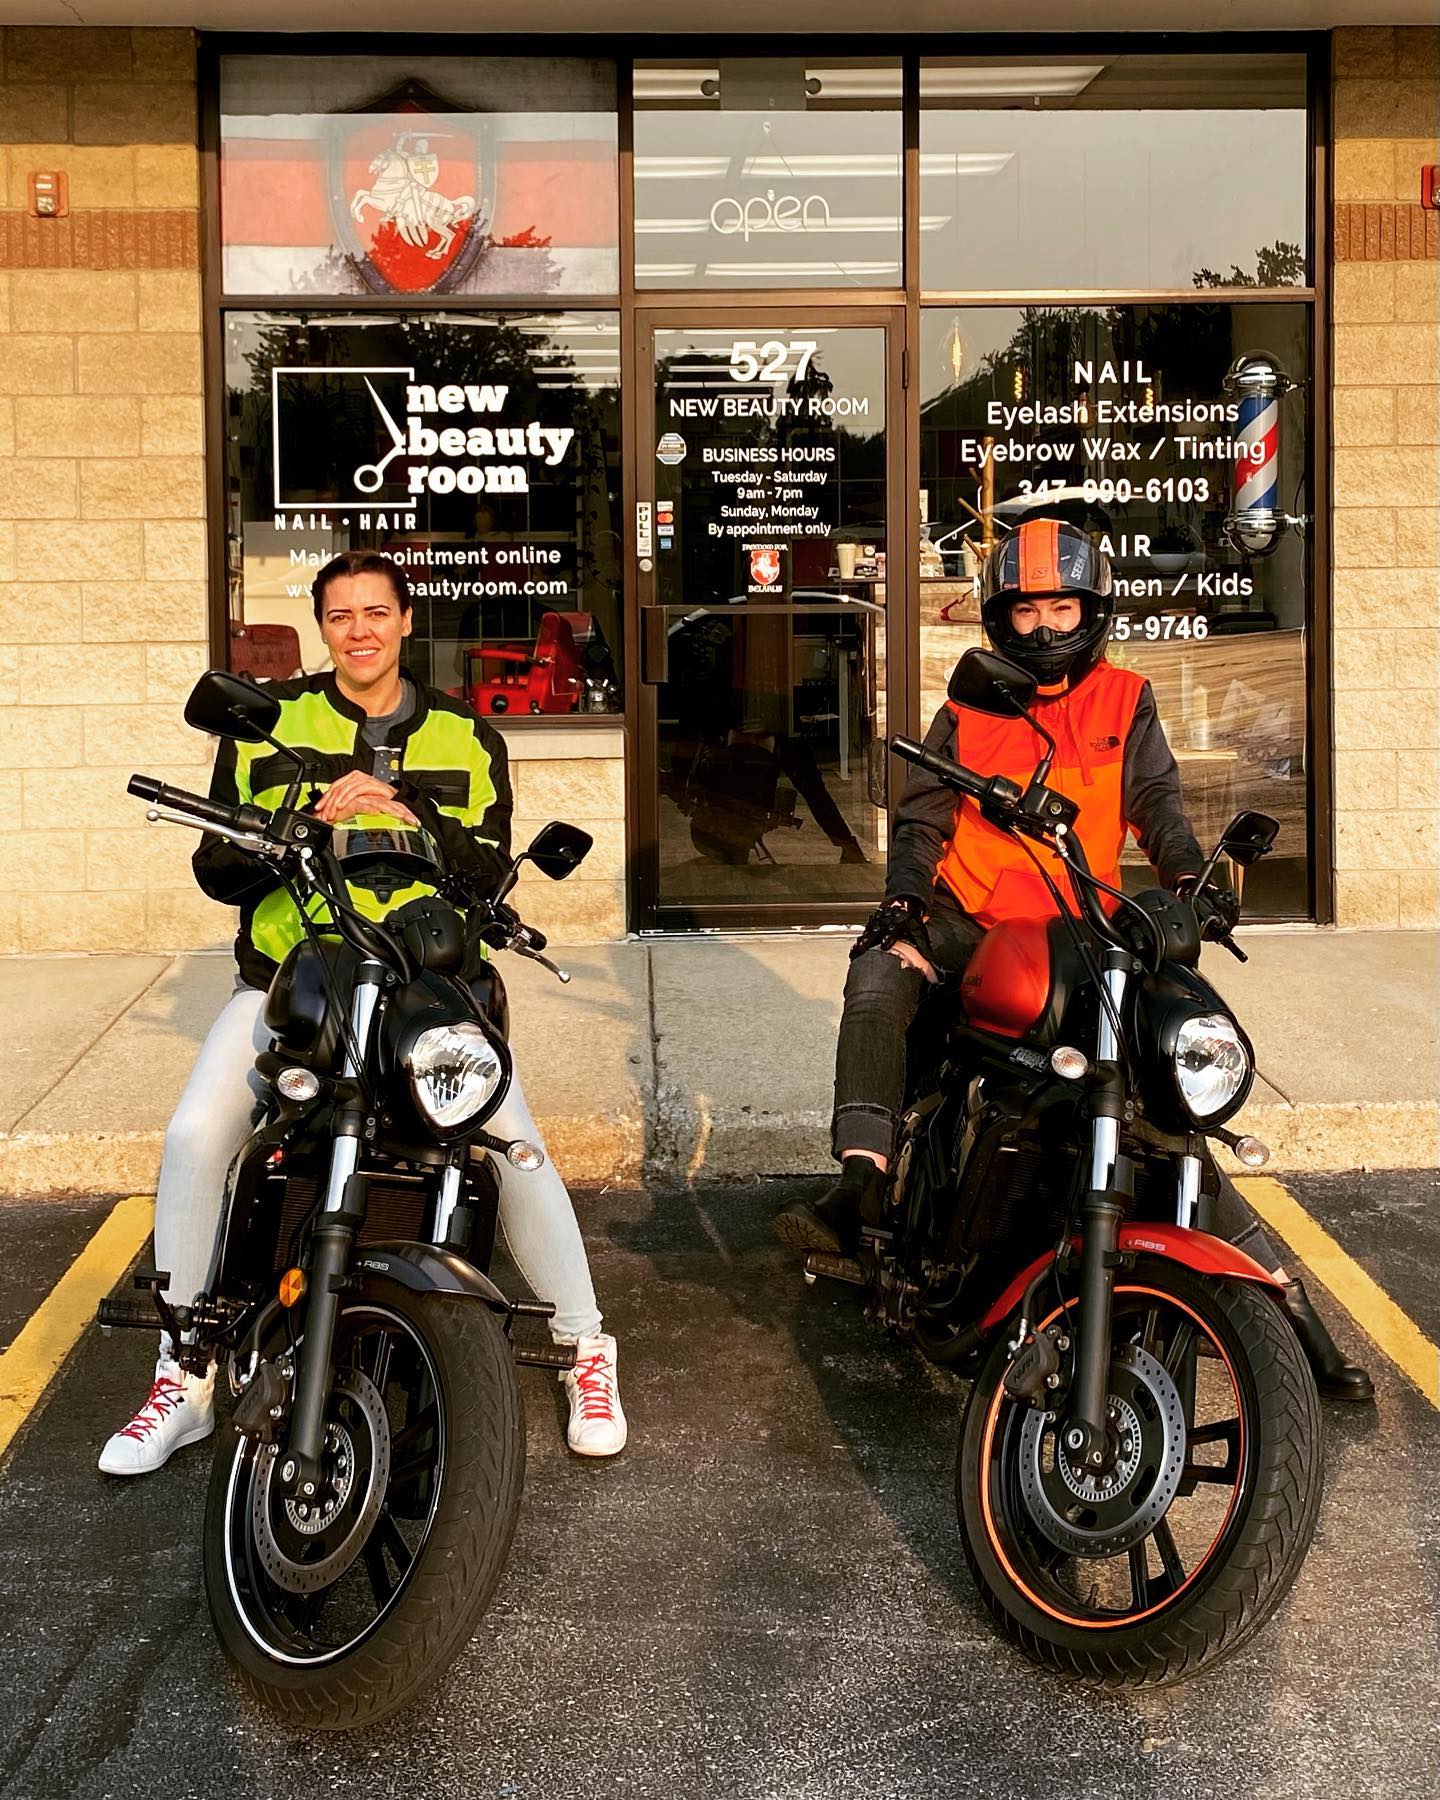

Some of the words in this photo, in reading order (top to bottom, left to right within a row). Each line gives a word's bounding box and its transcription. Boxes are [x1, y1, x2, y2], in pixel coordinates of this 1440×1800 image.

[710, 195, 831, 242] open
[728, 341, 817, 382] 527
[1074, 361, 1152, 384] NAIL
[406, 384, 509, 413] new
[670, 399, 720, 417] NEW
[723, 398, 804, 417] BEAUTY
[808, 397, 869, 416] ROOM
[987, 401, 1088, 430] Eyelash
[1097, 399, 1239, 423] Extensions
[407, 416, 574, 465] beauty
[961, 438, 1075, 467] Eyebrow
[1083, 438, 1141, 461] Wax
[1174, 435, 1266, 463] Tinting
[702, 448, 778, 463] BUSINESS
[781, 447, 836, 462] HOURS
[407, 464, 529, 493] room
[711, 470, 764, 486] Tuesday
[773, 470, 828, 486] Saturday
[736, 488, 765, 500] 9am
[774, 487, 803, 501] 7pm
[1018, 478, 1210, 504] 347990-6103
[274, 514, 332, 531] NAIL
[360, 513, 416, 530] HAIR
[638, 505, 649, 538] PULL
[720, 505, 769, 520] Sunday,
[771, 504, 819, 519] Monday
[708, 523, 725, 538] By
[727, 522, 803, 538] appointment
[805, 521, 832, 537] only
[495, 546, 561, 564] online
[742, 544, 774, 552] FREEDOM
[774, 543, 789, 552] FOR
[1098, 534, 1152, 558] AIR
[748, 583, 783, 593] BELARUS
[1198, 573, 1253, 597] Kids
[1134, 1239, 1166, 1252] ABS
[363, 1260, 390, 1271] ABS
